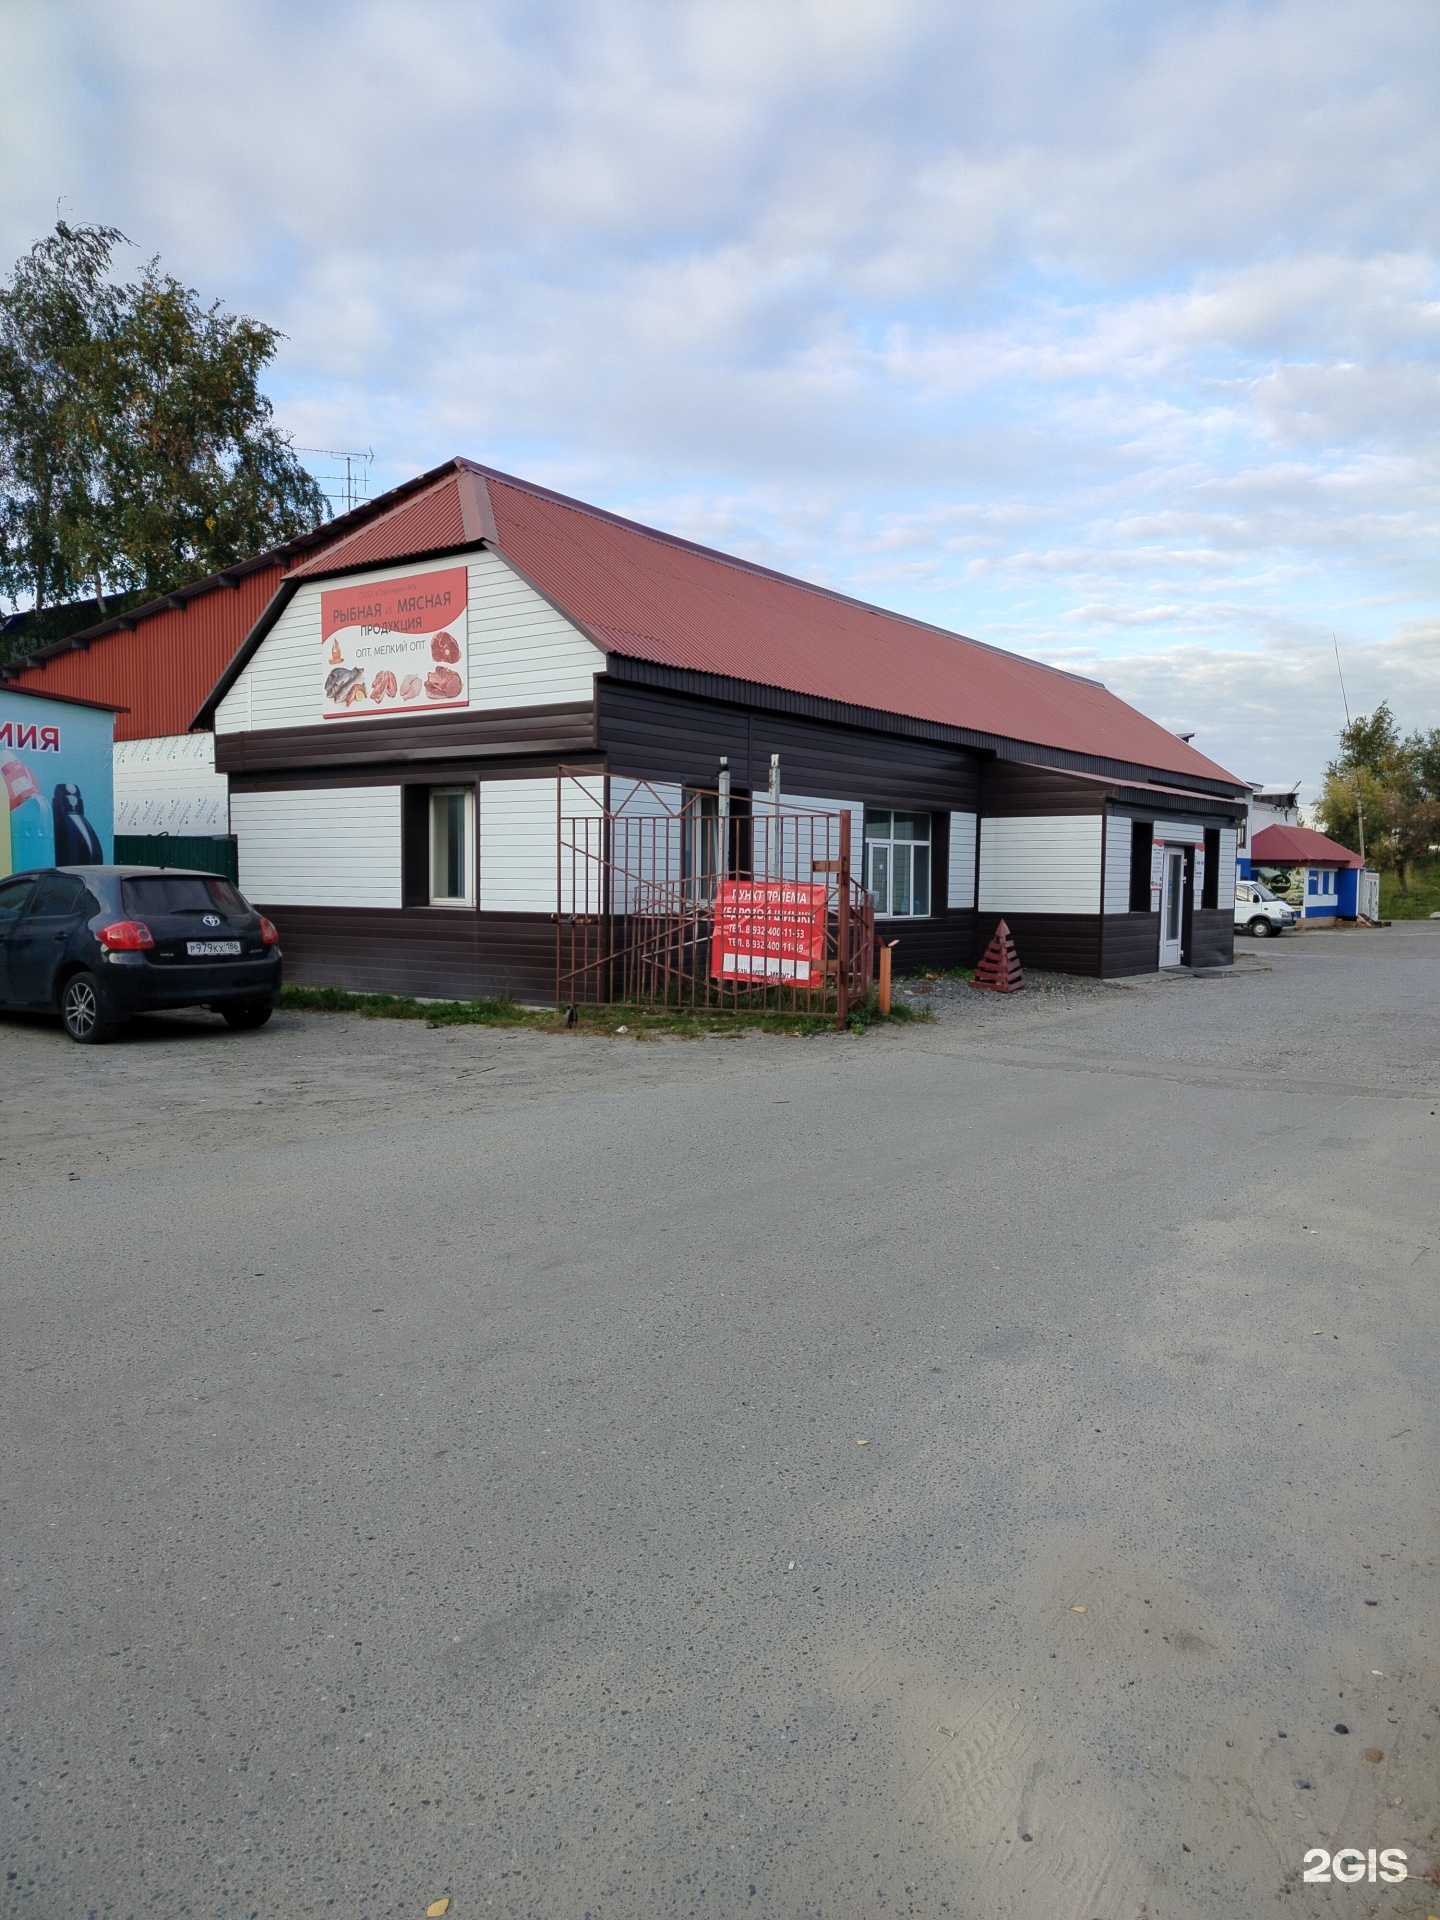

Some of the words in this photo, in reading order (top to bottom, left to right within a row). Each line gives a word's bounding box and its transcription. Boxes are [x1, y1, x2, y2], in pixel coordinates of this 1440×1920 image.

[333, 603, 382, 623] РЫБНАЯ
[397, 591, 452, 613] МЯСНАЯ
[360, 616, 423, 637] ПРОДУКЦИЯ
[374, 640, 408, 656] МЕЛКИЙ
[409, 639, 426, 652] ОПТ
